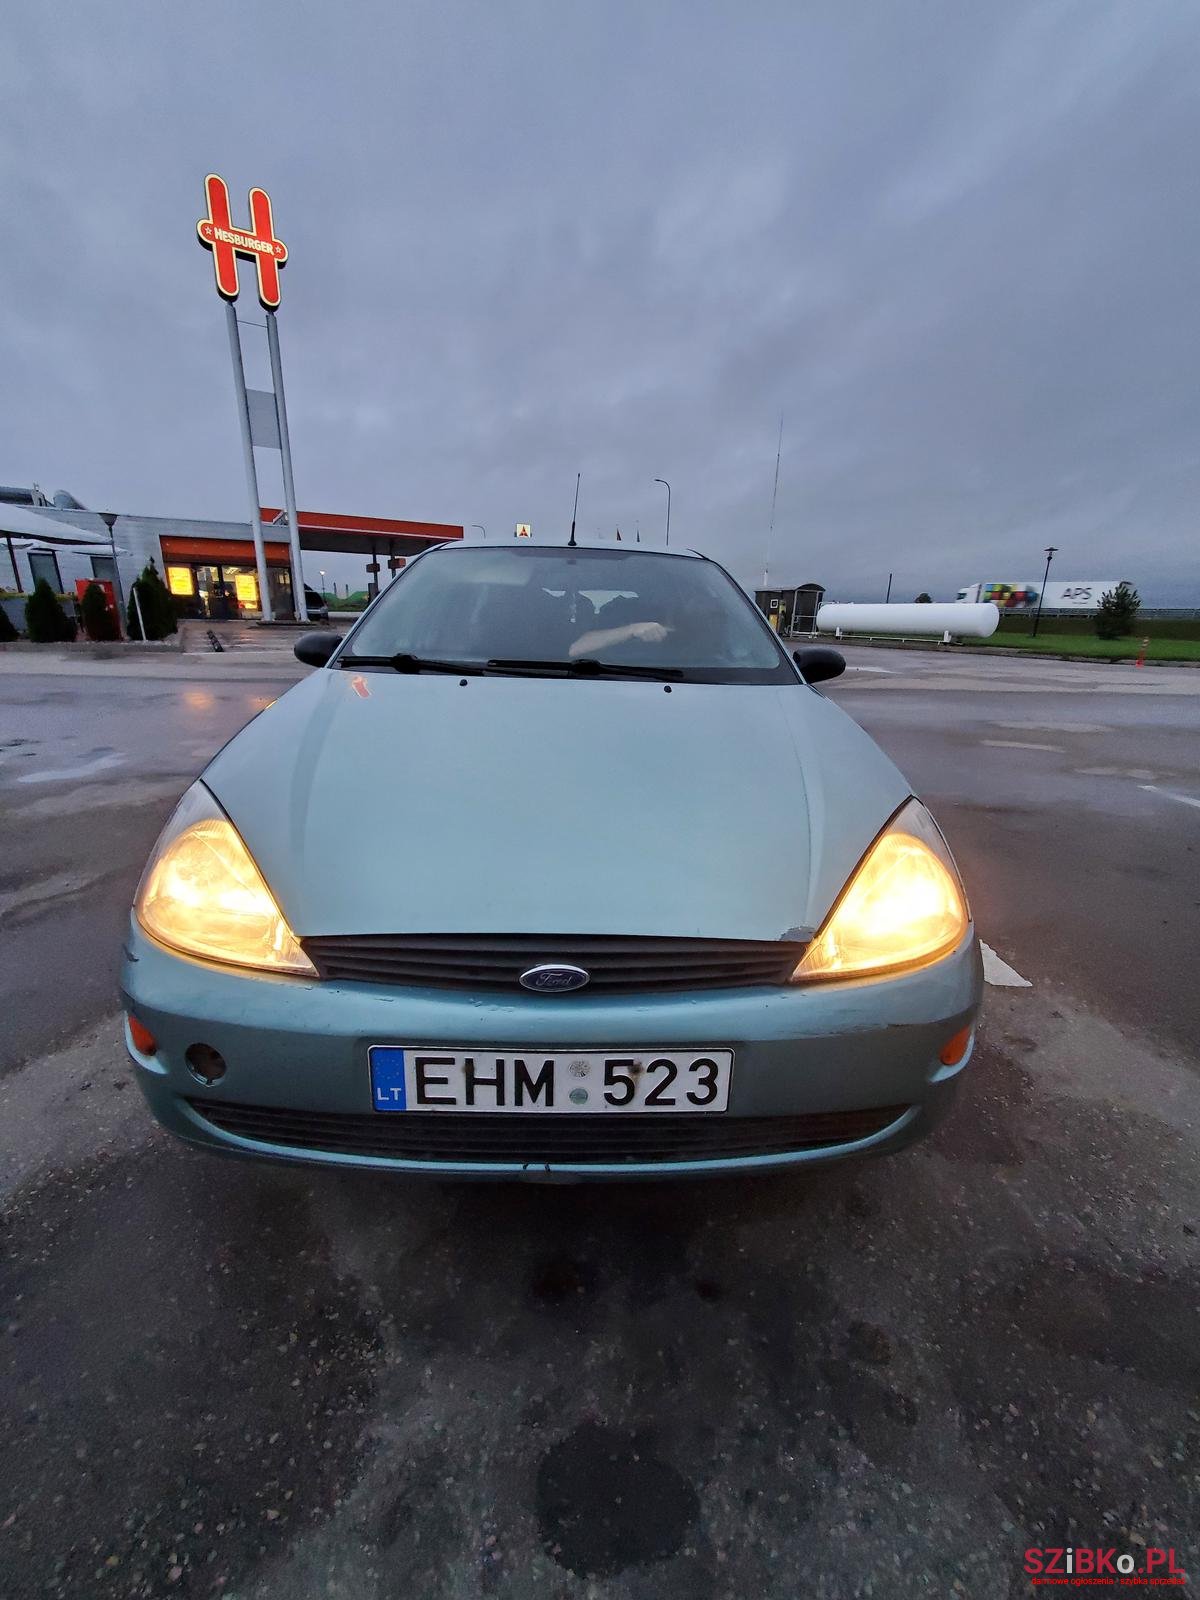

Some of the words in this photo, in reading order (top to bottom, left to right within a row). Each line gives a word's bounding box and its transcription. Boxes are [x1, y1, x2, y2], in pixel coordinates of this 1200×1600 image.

[214, 227, 274, 255] HESBURGER
[1061, 587, 1092, 600] APS
[536, 972, 573, 986] Ford
[415, 1057, 555, 1107] EHM
[603, 1058, 719, 1106] 523
[376, 1088, 402, 1101] LT
